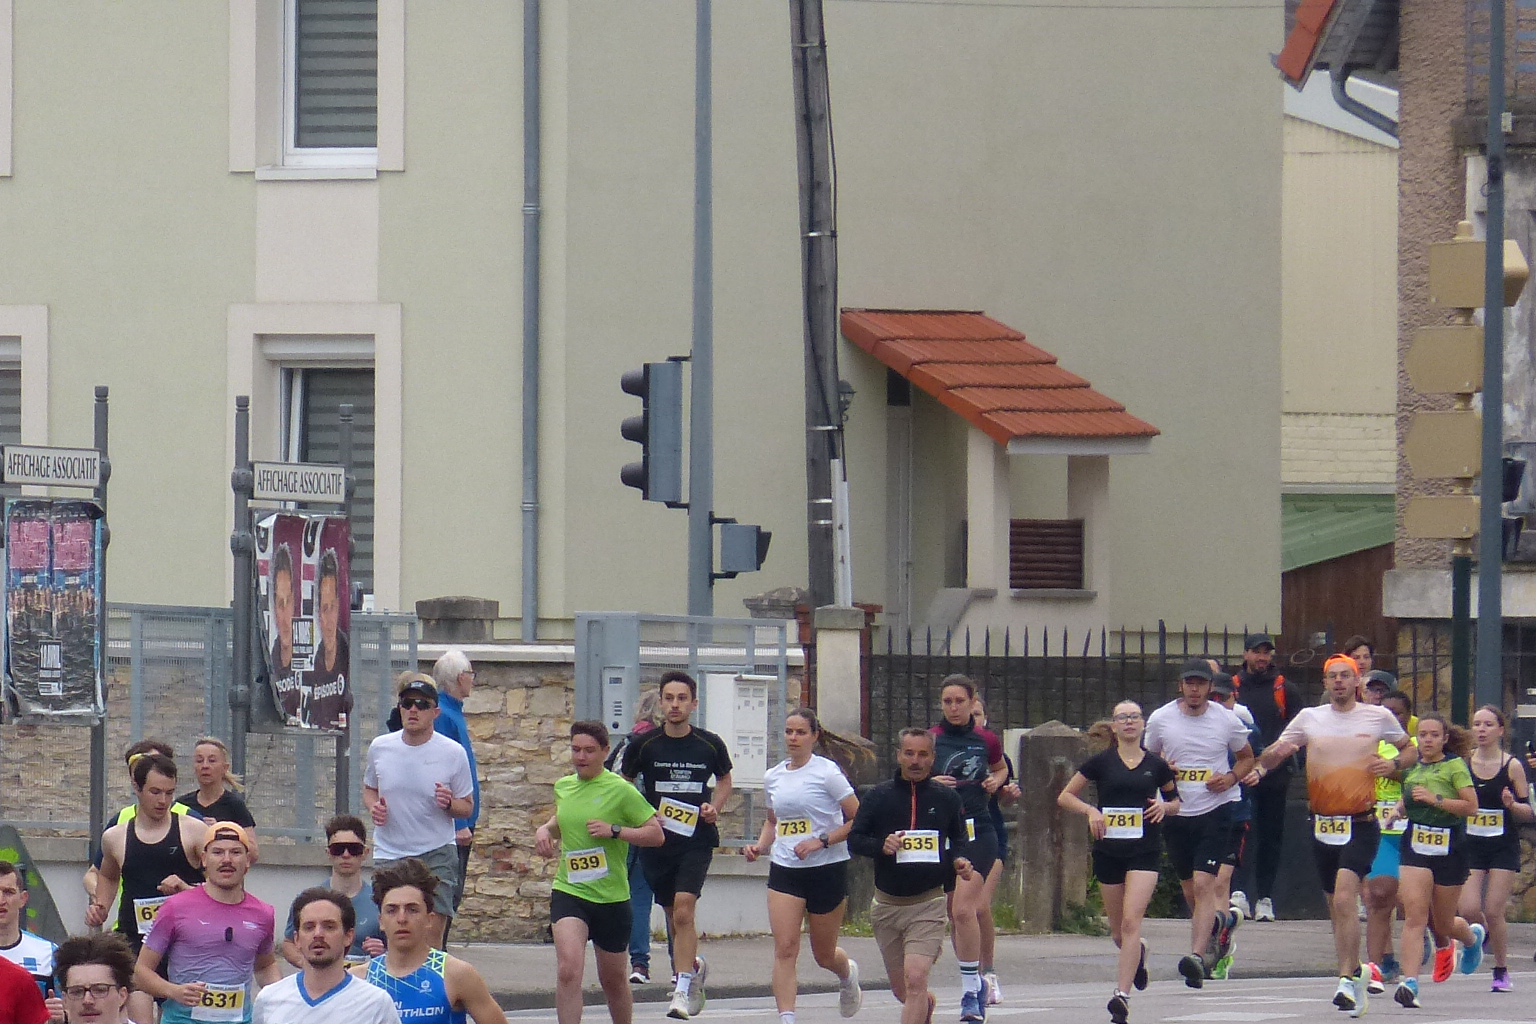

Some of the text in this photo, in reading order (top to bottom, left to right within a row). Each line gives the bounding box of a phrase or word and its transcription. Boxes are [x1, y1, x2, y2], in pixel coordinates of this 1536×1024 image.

[7, 453, 97, 480] AFFICHAGE ASSOCIATIF
[258, 470, 342, 495] AFFICHAGE ASSOCIATIF
[1179, 770, 1207, 781] 787
[664, 805, 694, 824] 627
[1107, 815, 1136, 826] 781
[1472, 815, 1498, 826] 713
[781, 821, 807, 834] 733
[1320, 822, 1345, 834] 614
[902, 837, 934, 850] 635
[1417, 832, 1443, 845] 618
[570, 855, 600, 871] 639
[202, 992, 238, 1008] 631
[397, 1006, 444, 1018] ATHLON
